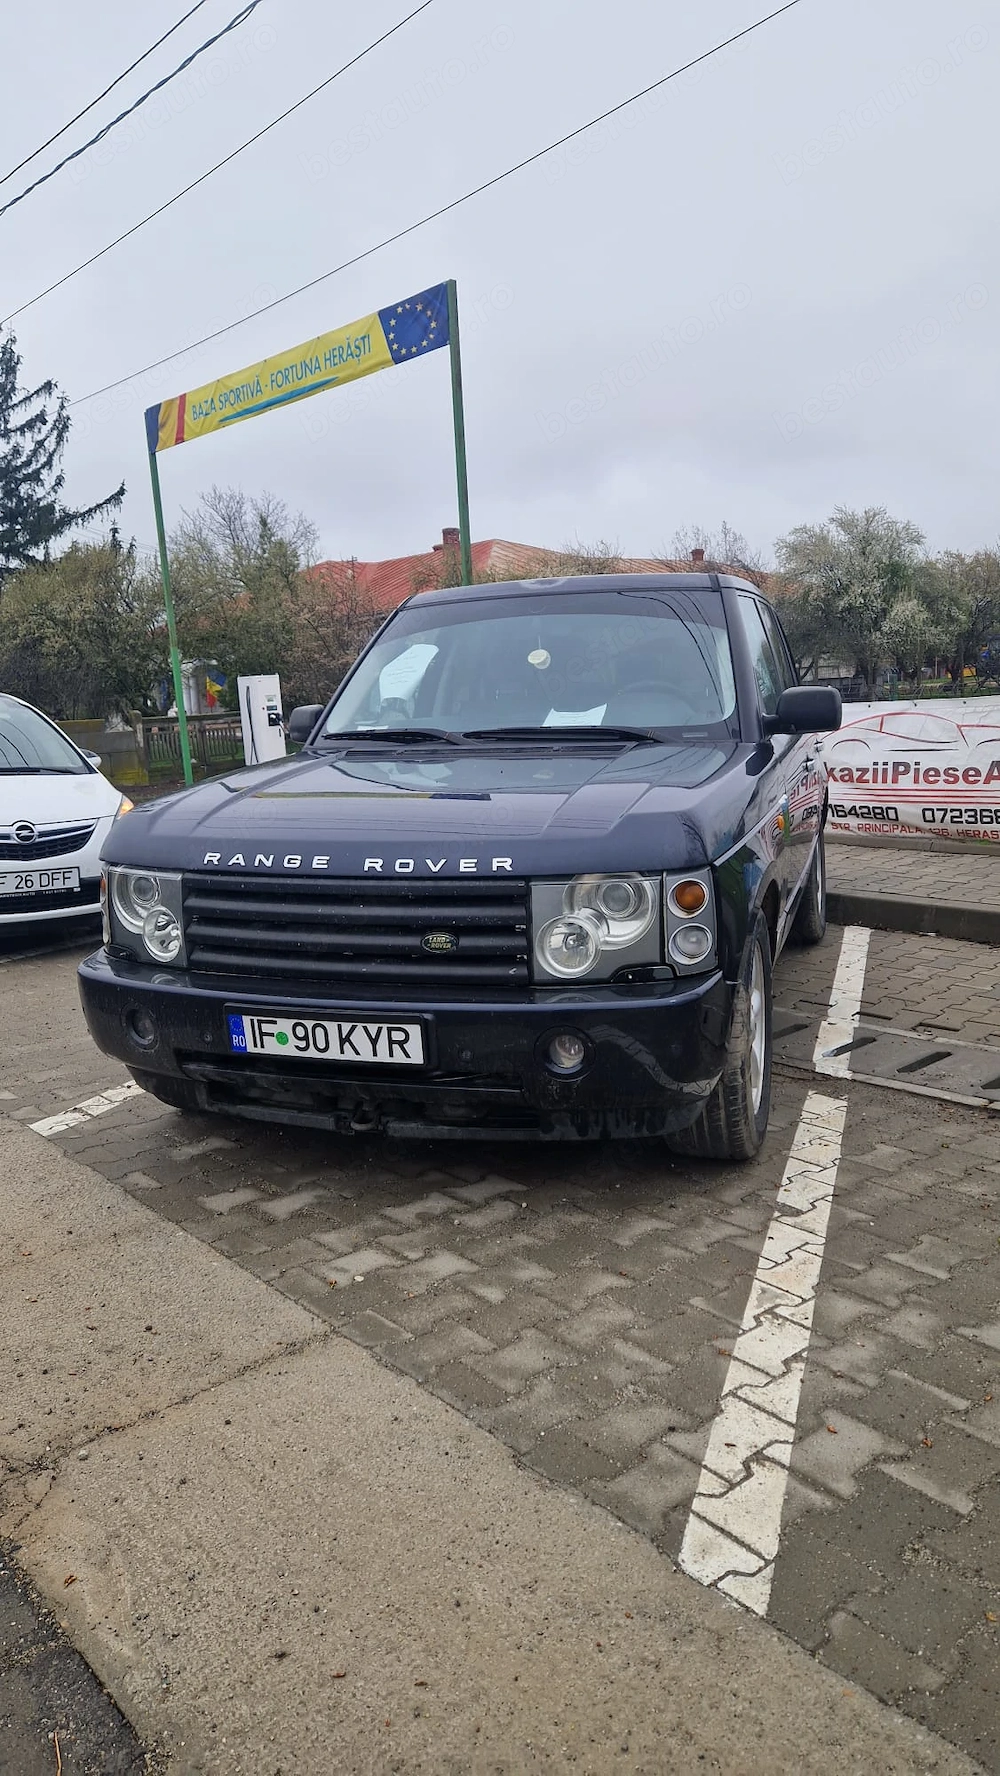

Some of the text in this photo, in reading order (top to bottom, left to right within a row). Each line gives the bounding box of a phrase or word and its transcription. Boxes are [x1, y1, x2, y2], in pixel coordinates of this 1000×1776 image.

[191, 399, 217, 421] BAZA
[218, 375, 263, 410] SPORTIVĂ
[270, 357, 322, 391] FORTUNA
[323, 333, 372, 370] HERĂȘTI
[203, 852, 514, 873] RANGE ROVER
[14, 874, 34, 890] 26
[39, 871, 73, 887] DFF
[232, 1035, 246, 1047] RO
[249, 1018, 412, 1059] IF 90 KYR
